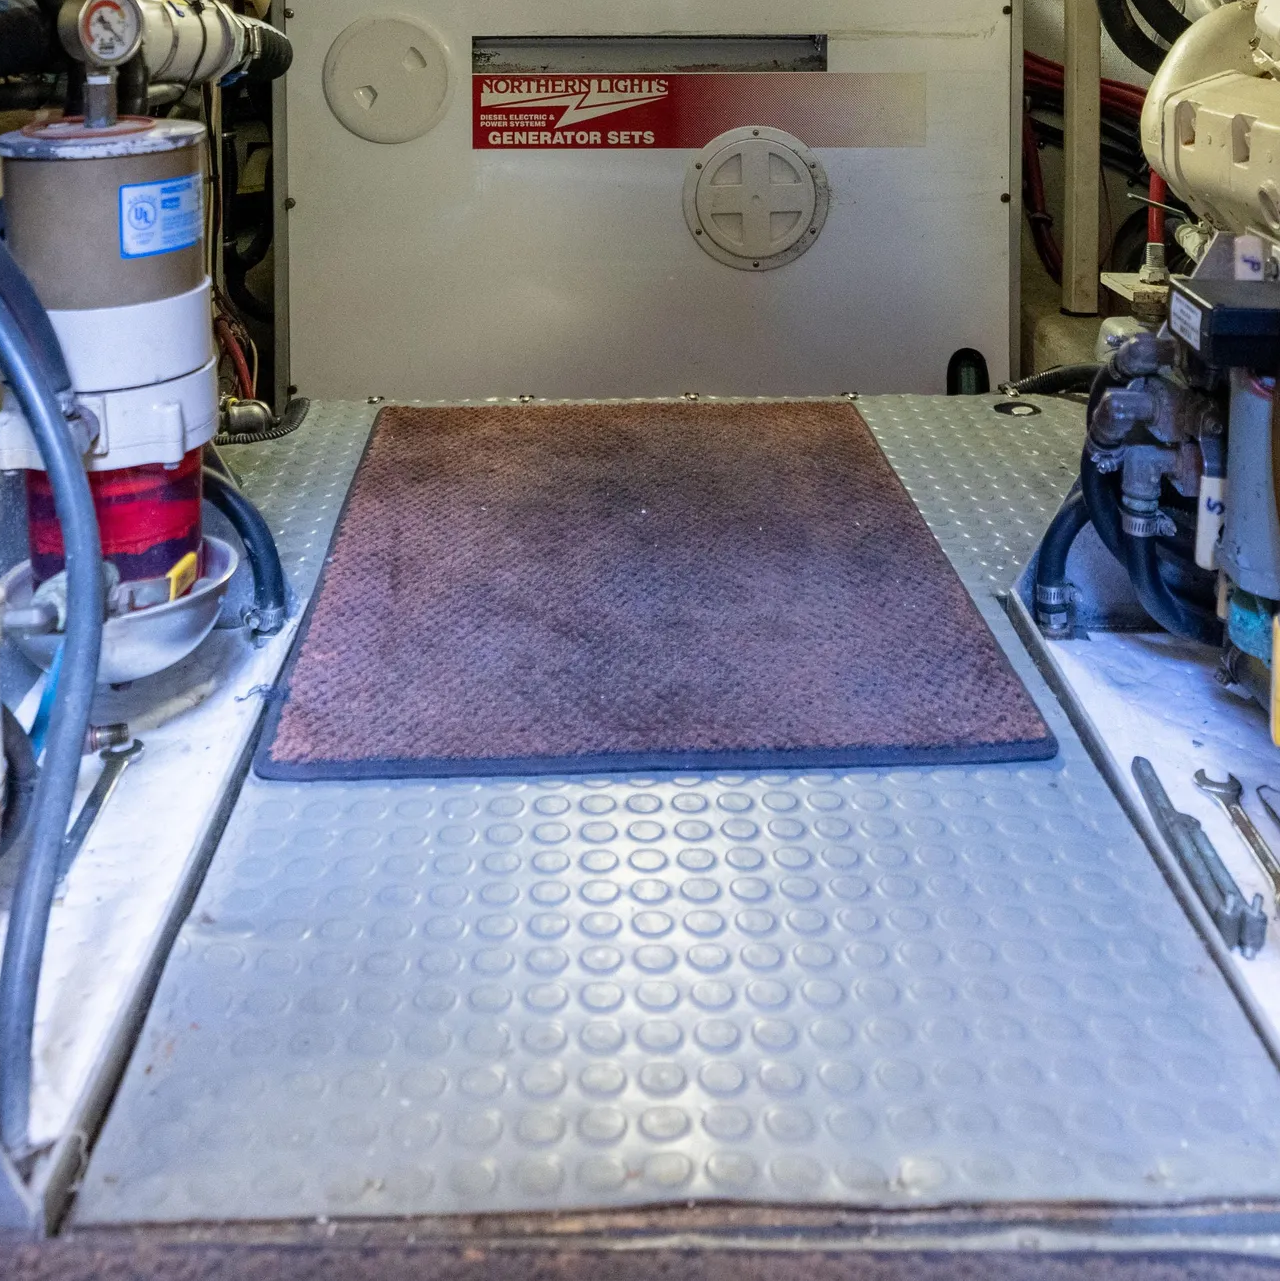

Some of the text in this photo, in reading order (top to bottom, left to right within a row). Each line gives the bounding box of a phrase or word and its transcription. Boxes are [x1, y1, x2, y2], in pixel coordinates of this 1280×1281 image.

[481, 79, 668, 94] NORTHERN LIGHTS
[488, 131, 655, 145] GENERATOR SETS
[134, 207, 152, 224] UL
[1206, 495, 1226, 516] S
